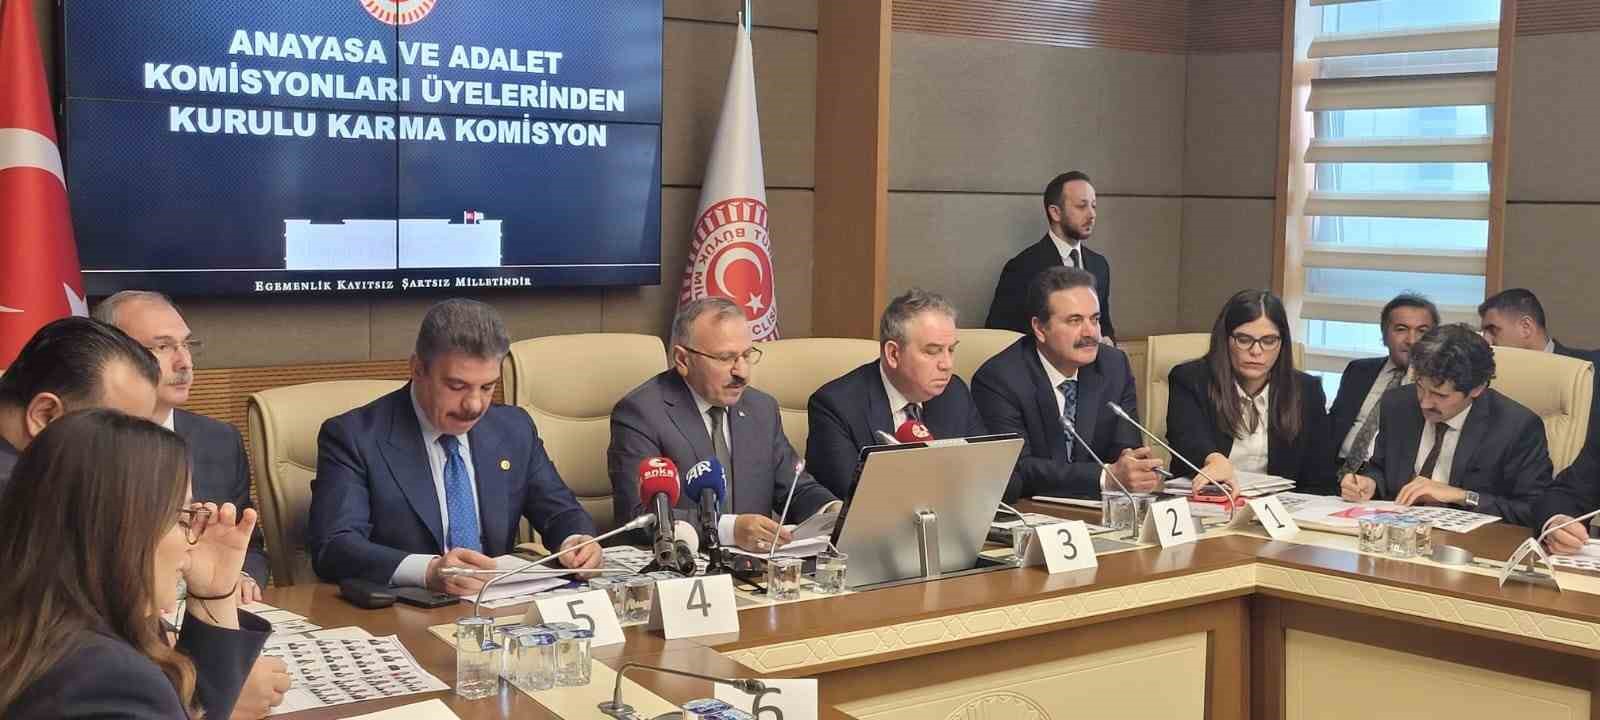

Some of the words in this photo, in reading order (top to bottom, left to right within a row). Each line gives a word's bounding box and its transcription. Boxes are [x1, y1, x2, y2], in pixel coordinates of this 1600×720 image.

[229, 29, 388, 64] ANAYASA
[398, 41, 440, 68] VE
[448, 45, 564, 75] ADALET
[144, 61, 410, 102] KOMİSYONLARI
[421, 74, 625, 112] ÜYELERİNDEN
[169, 106, 317, 137] KURULU
[328, 113, 447, 141] KARMA
[455, 113, 607, 147] KOMİSYON
[255, 280, 332, 292] EGEMENLİK
[336, 280, 394, 290] KAYITSIZ
[401, 278, 450, 290] ŞARTSIZ
[455, 276, 532, 288] MİLLETİNDİR
[1166, 507, 1183, 538] 2
[1264, 503, 1286, 529] 1
[1057, 528, 1078, 560] 3
[686, 579, 712, 617] 4
[566, 599, 595, 635] 5
